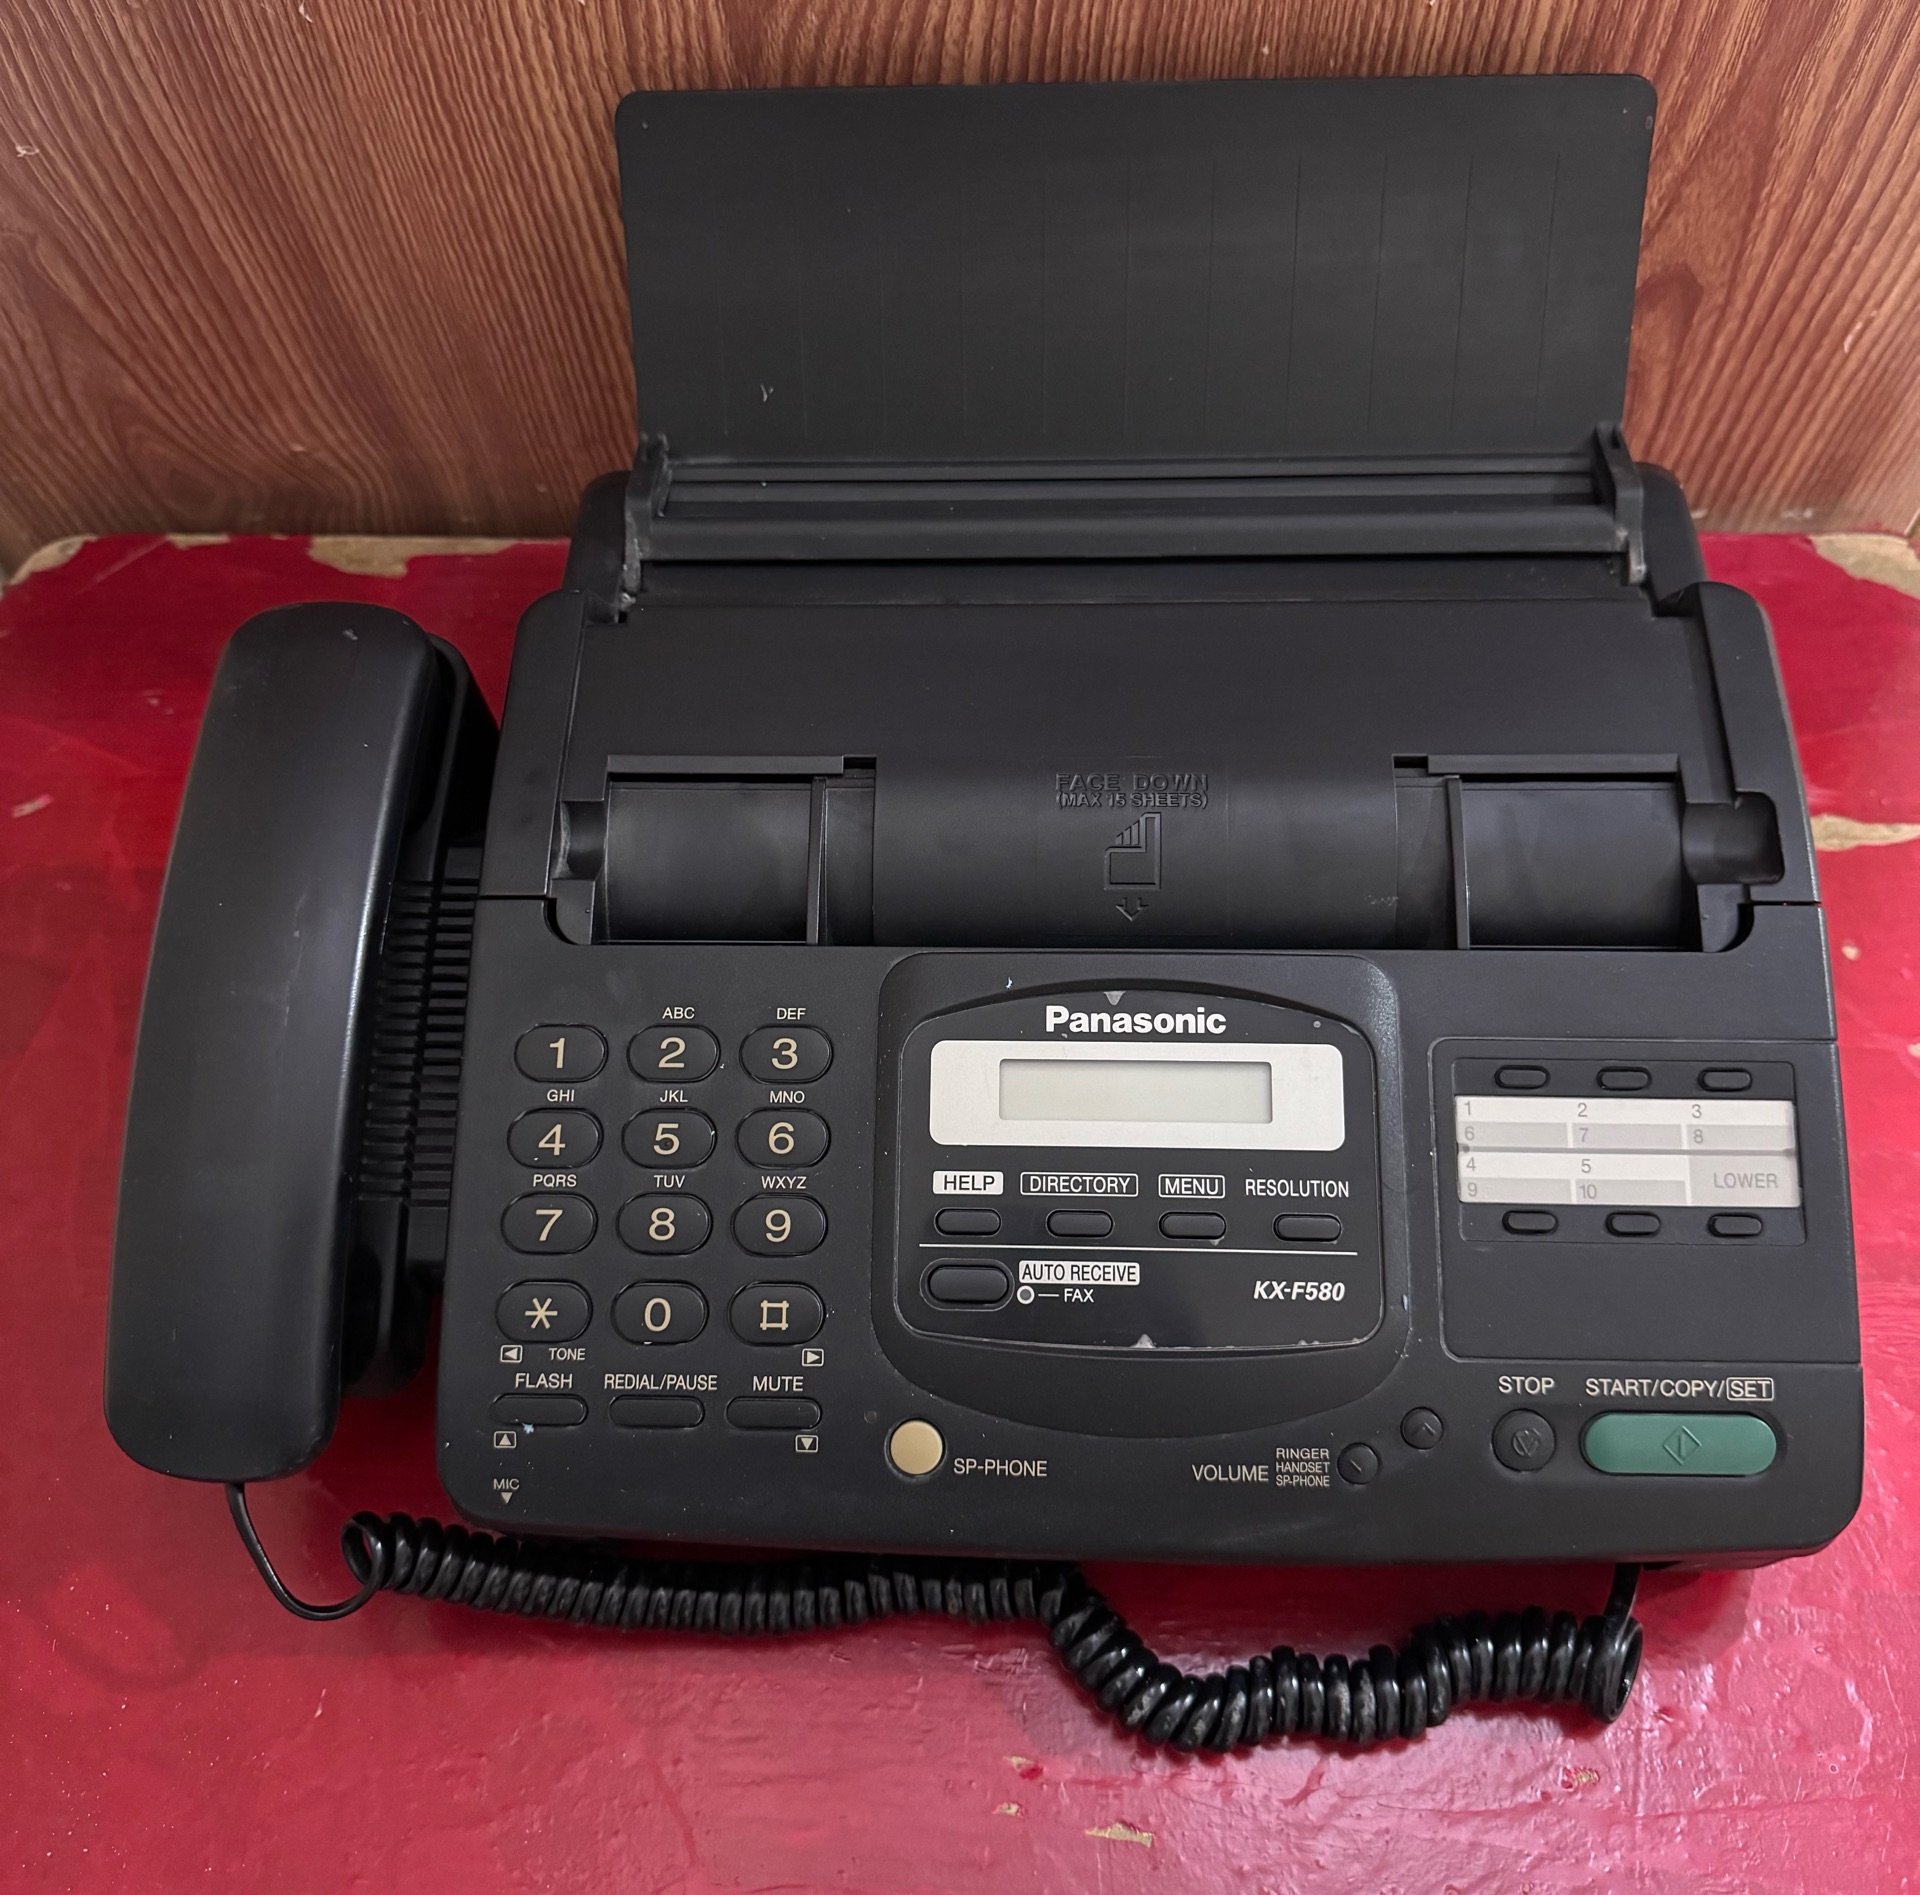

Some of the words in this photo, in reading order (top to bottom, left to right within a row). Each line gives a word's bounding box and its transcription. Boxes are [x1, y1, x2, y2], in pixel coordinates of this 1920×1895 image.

[1055, 773, 1120, 791] FACE
[1133, 773, 1208, 791] DOWN
[1057, 793, 1102, 809] (MAX
[1106, 794, 1127, 808] 15
[1129, 793, 1208, 809] SHEETS)
[662, 1006, 695, 1020] ABC
[776, 1007, 806, 1020] DEF
[1045, 1005, 1227, 1034] Panasonic
[549, 1037, 566, 1069] 1
[658, 1037, 686, 1068] 2
[771, 1037, 798, 1070] 3
[546, 1089, 575, 1102] GHI
[659, 1089, 689, 1103] JKL
[769, 1090, 805, 1104] MNO
[1464, 1100, 1471, 1116] 1
[1577, 1102, 1588, 1118] 2
[1691, 1103, 1702, 1119] 3
[538, 1123, 566, 1156] 4
[653, 1123, 680, 1155] 5
[768, 1121, 795, 1155] 6
[1464, 1125, 1475, 1142] 6
[1578, 1127, 1589, 1143] 7
[1693, 1128, 1704, 1144] 8
[1465, 1156, 1477, 1172] 4
[1581, 1158, 1592, 1174] 5
[532, 1174, 577, 1188] PQRS
[653, 1174, 686, 1188] TUV
[761, 1175, 807, 1189] WXYZ
[943, 1174, 995, 1191] HELP
[1029, 1177, 1131, 1194] DIRECTORY
[1165, 1177, 1219, 1195] MENU
[1245, 1178, 1349, 1198] RESOLUTION
[1713, 1172, 1778, 1189] LOWER
[1467, 1182, 1478, 1198] 9
[1579, 1183, 1598, 1200] 10
[535, 1209, 563, 1242] 7
[649, 1207, 676, 1241] 8
[765, 1209, 791, 1243] 9
[1021, 1263, 1066, 1281] AUTO
[1070, 1264, 1137, 1282] RECEIVE
[1064, 1288, 1095, 1303] FAX
[1253, 1280, 1346, 1302] KX-F580
[644, 1297, 671, 1332] 0
[548, 1347, 586, 1361] TONE
[515, 1372, 573, 1389] FLASH
[604, 1373, 718, 1391] REDIAL/PAUSE
[752, 1375, 804, 1392] MUTE
[1498, 1375, 1555, 1395] STOP
[1276, 1447, 1330, 1460] RINGER
[953, 1457, 1048, 1477] SP-PHONE
[1191, 1464, 1269, 1482] VOLUME
[1275, 1461, 1330, 1473] HANDSET
[493, 1478, 520, 1490] MIC
[1275, 1474, 1330, 1487] SP-PHONE
